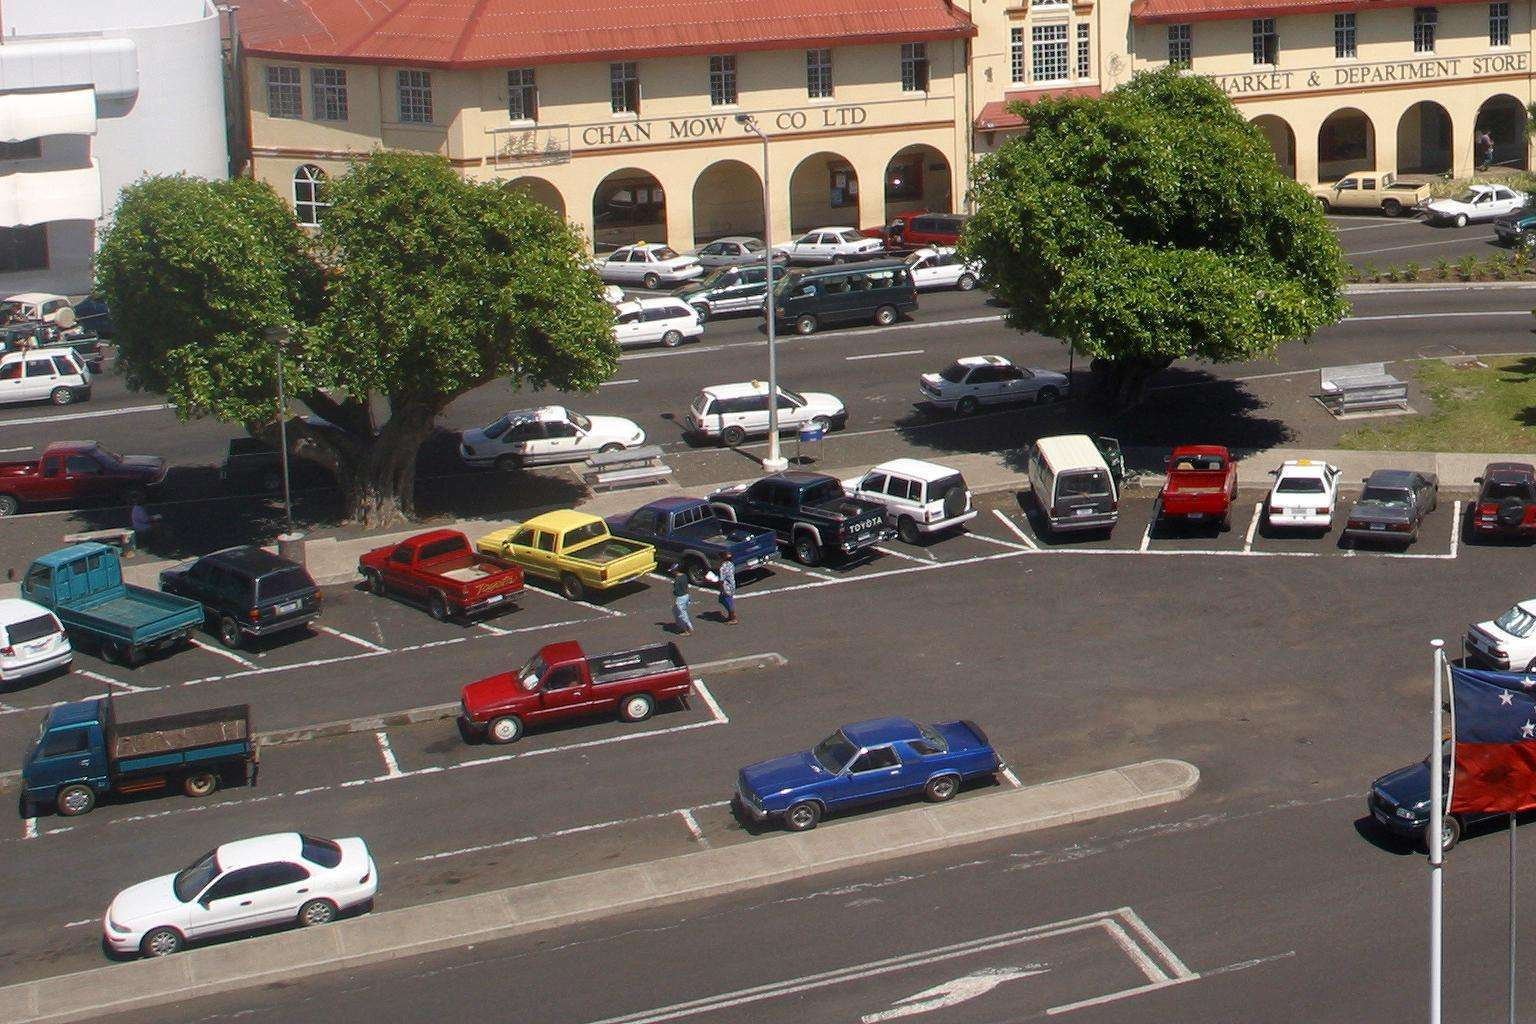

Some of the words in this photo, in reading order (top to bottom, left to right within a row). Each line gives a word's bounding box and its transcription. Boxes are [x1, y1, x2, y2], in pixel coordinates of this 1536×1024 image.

[1307, 70, 1320, 88] &
[1334, 59, 1462, 86] DEPARTMENT
[1472, 54, 1528, 74] STORE
[582, 123, 652, 146] CHAN
[669, 116, 727, 139] MOW
[743, 114, 759, 134] &
[775, 111, 807, 131] CO
[823, 107, 867, 127] LTD
[849, 516, 883, 534] TOYOTA
